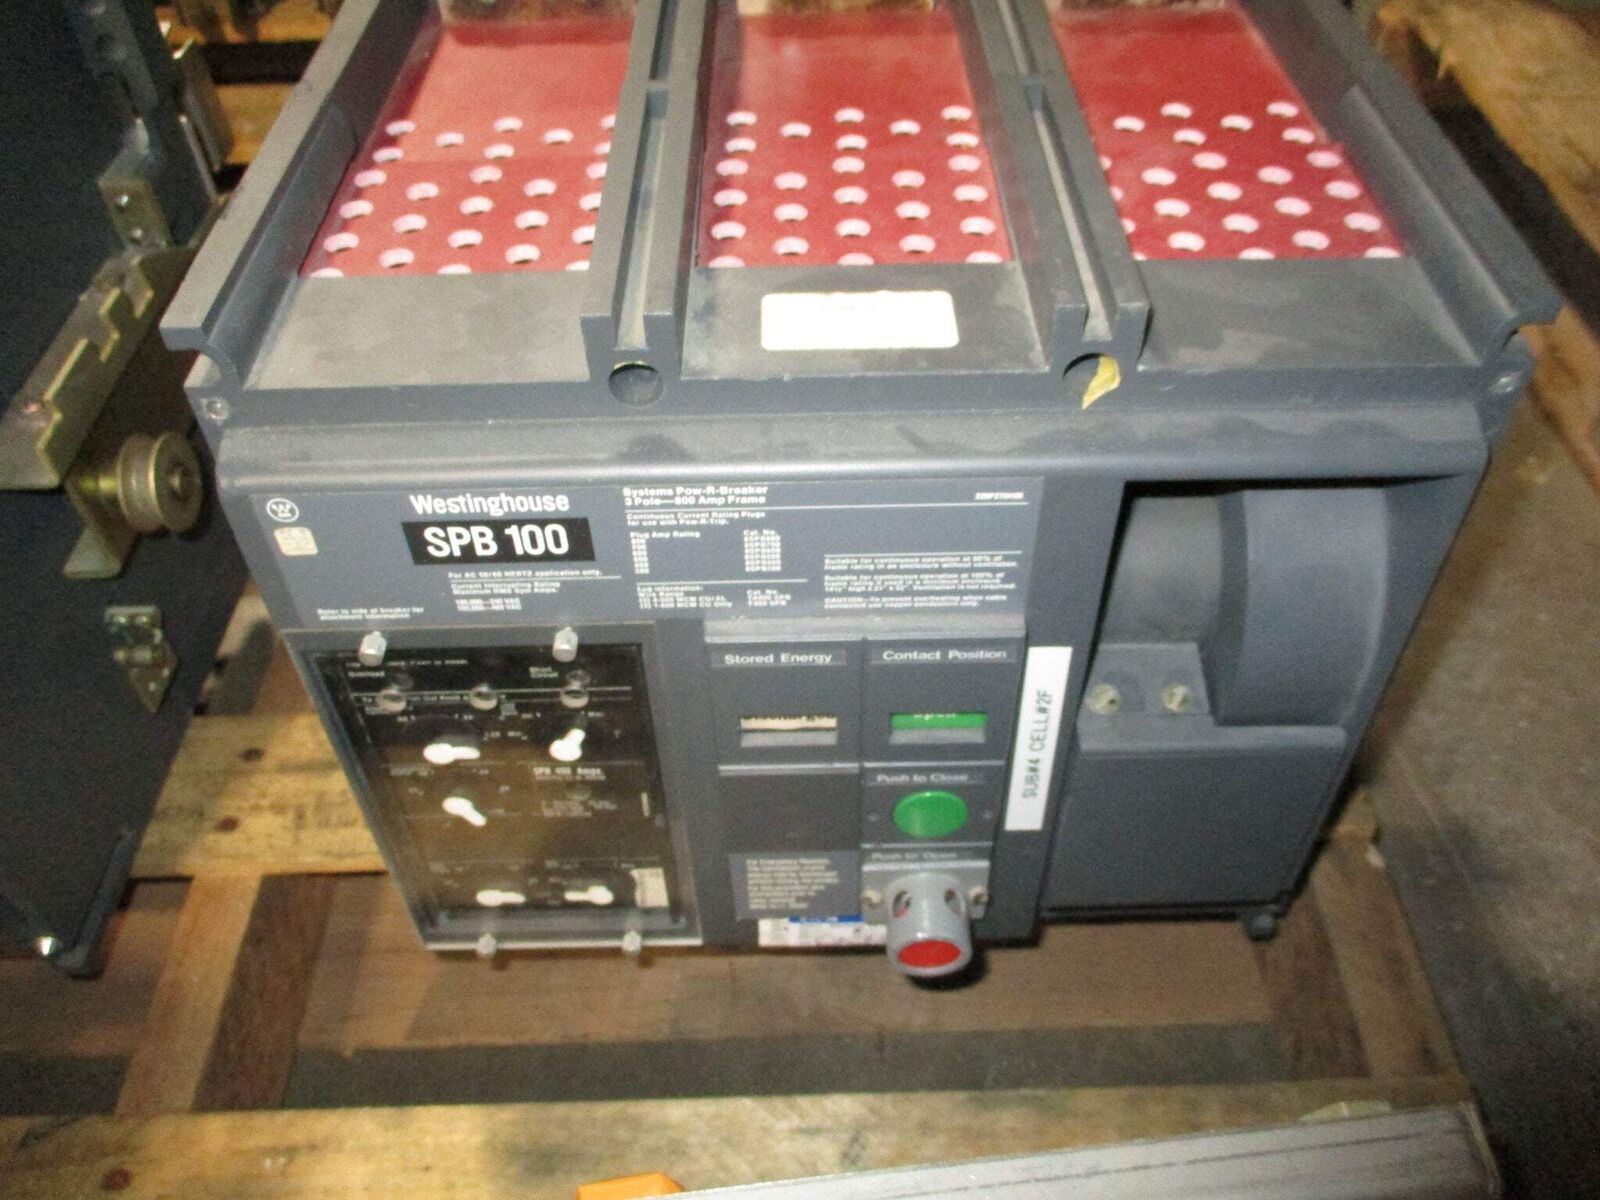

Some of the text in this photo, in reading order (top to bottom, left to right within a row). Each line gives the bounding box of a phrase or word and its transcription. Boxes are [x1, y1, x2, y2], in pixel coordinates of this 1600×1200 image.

[622, 486, 769, 497] Systems Pow-R-Breaker
[409, 492, 570, 516] Westinghouse
[624, 497, 633, 506] 3
[698, 496, 725, 506] Amp
[727, 495, 767, 504] Frame
[677, 512, 711, 520] Current
[711, 512, 739, 520] Rating
[740, 511, 766, 519] Plugs
[423, 523, 570, 558] SPB 100
[651, 532, 672, 540] Amp
[672, 531, 701, 539] Rating
[724, 652, 833, 666] Stored Energy
[882, 648, 1008, 661] Contact Position
[1022, 689, 1053, 799] SUB#4 CELL#2F
[876, 773, 969, 783] Push to Close
